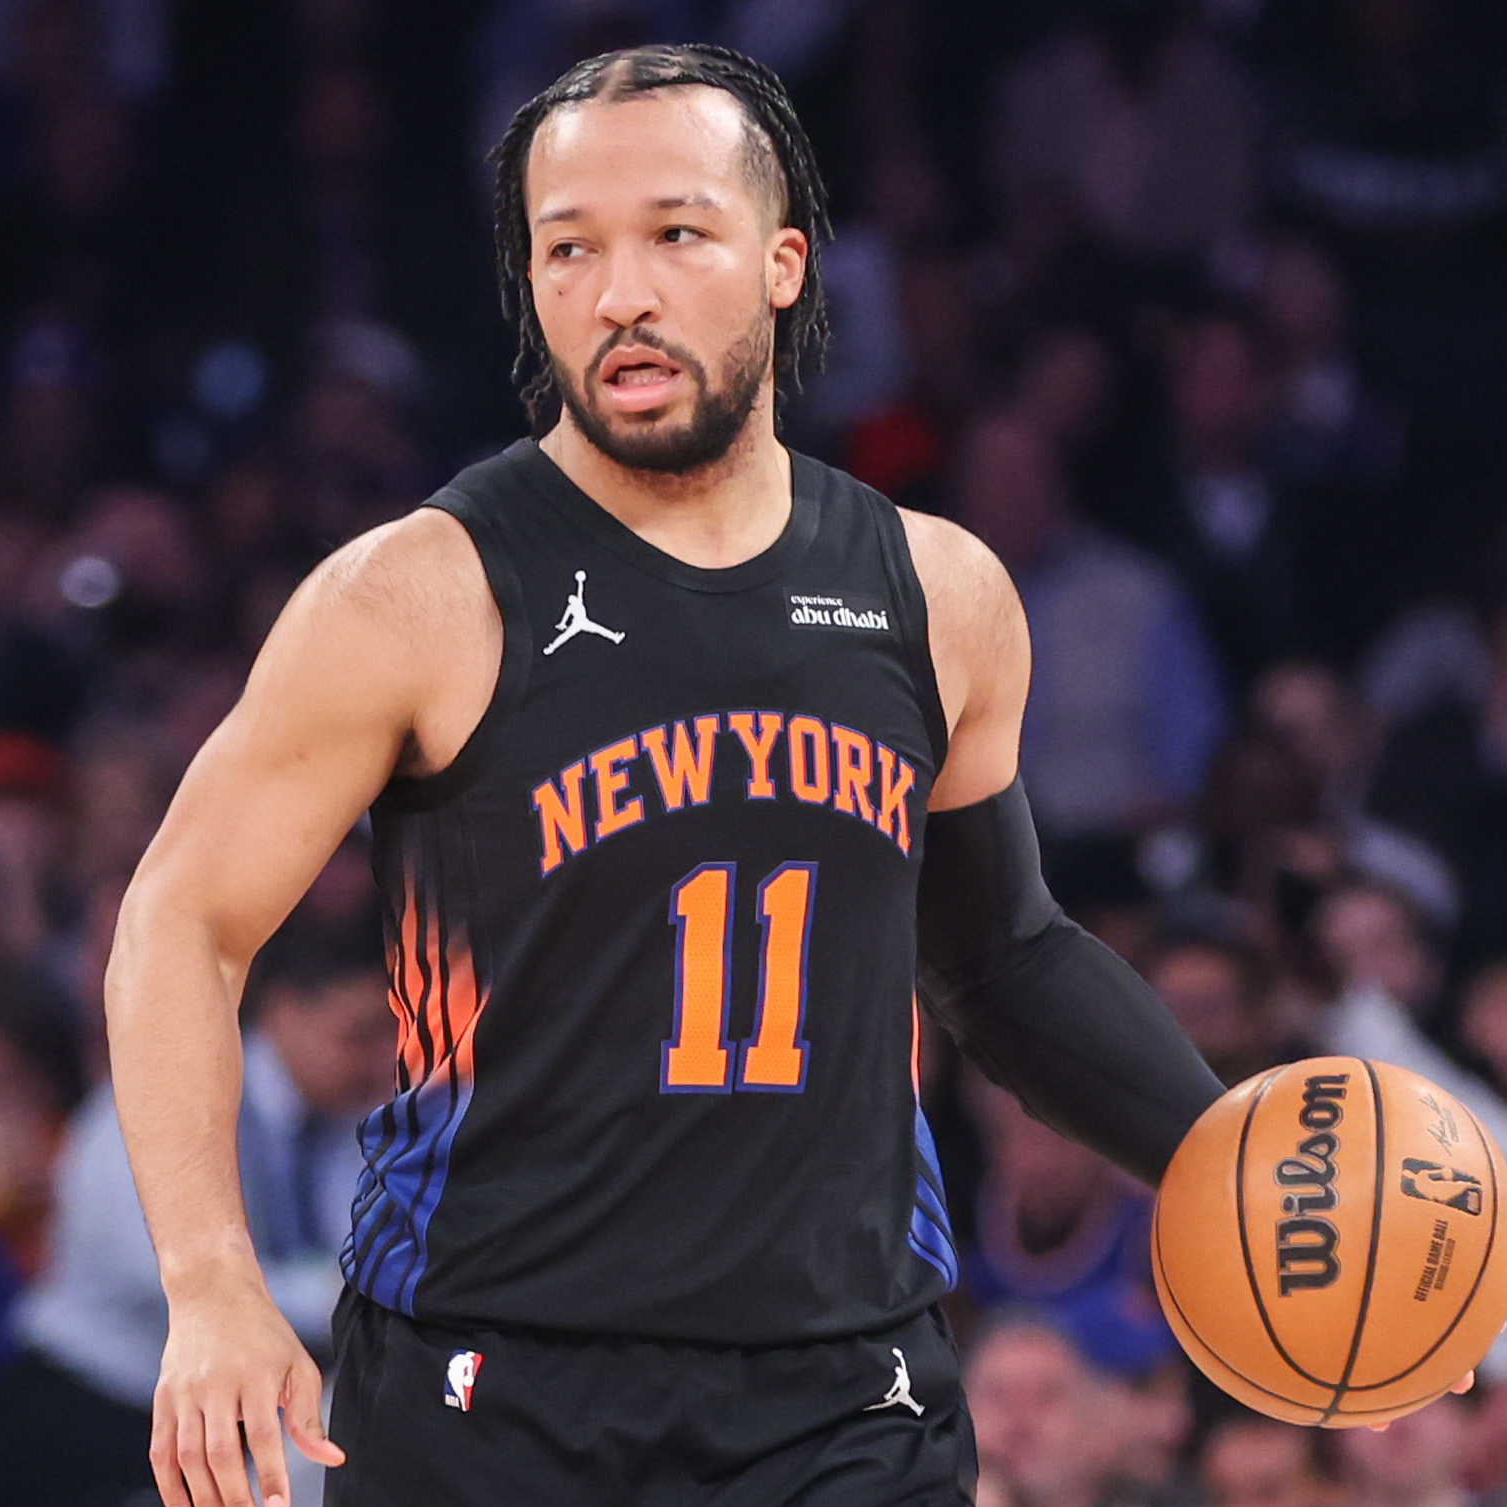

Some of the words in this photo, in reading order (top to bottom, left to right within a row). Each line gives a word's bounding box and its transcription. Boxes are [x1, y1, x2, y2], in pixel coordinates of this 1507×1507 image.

[791, 595, 843, 606] experience
[791, 605, 832, 625] abu
[833, 607, 889, 630] dhabi
[531, 713, 721, 879] NEW
[728, 710, 916, 858] YORK
[660, 860, 819, 1094] 11
[1274, 1074, 1349, 1297] Wilson
[1433, 1219, 1448, 1240] BALL
